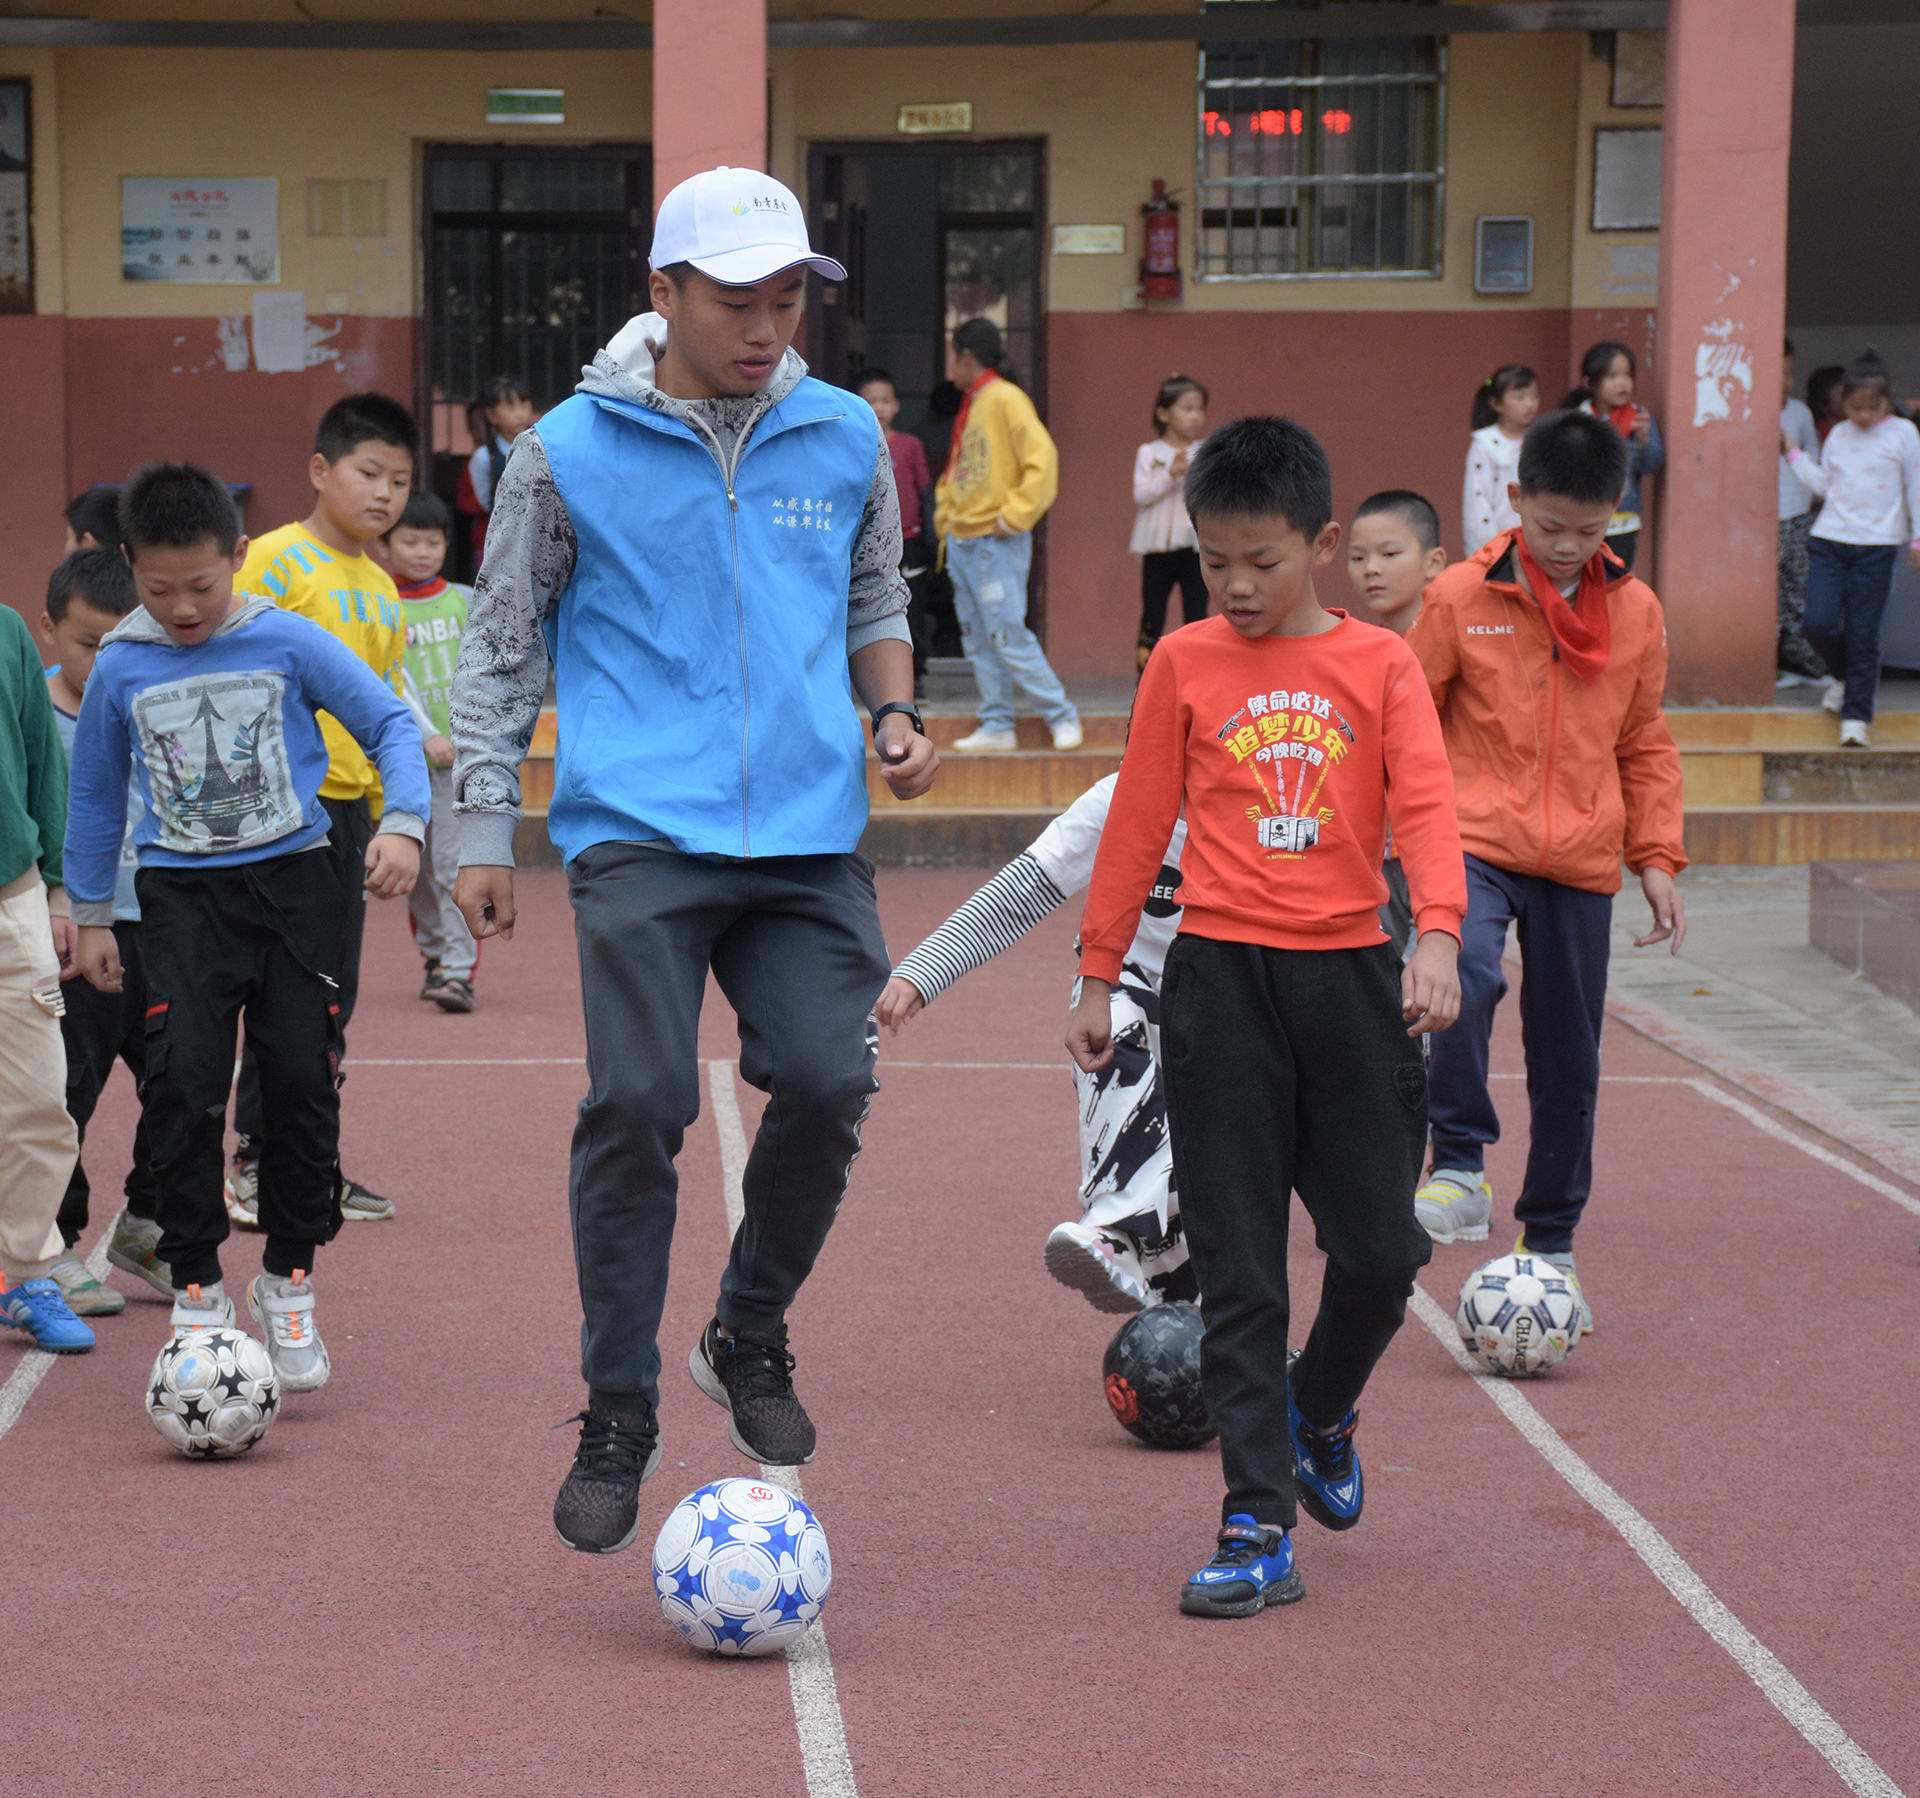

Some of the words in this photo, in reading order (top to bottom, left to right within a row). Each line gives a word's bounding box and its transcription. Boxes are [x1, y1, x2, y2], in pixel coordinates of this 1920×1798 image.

[415, 615, 461, 647] NBA
[1466, 625, 1515, 635] KELME
[1247, 690, 1333, 719] 使命必达
[1223, 712, 1349, 765] 追梦少年
[1255, 742, 1324, 767] 今晚吃鸡
